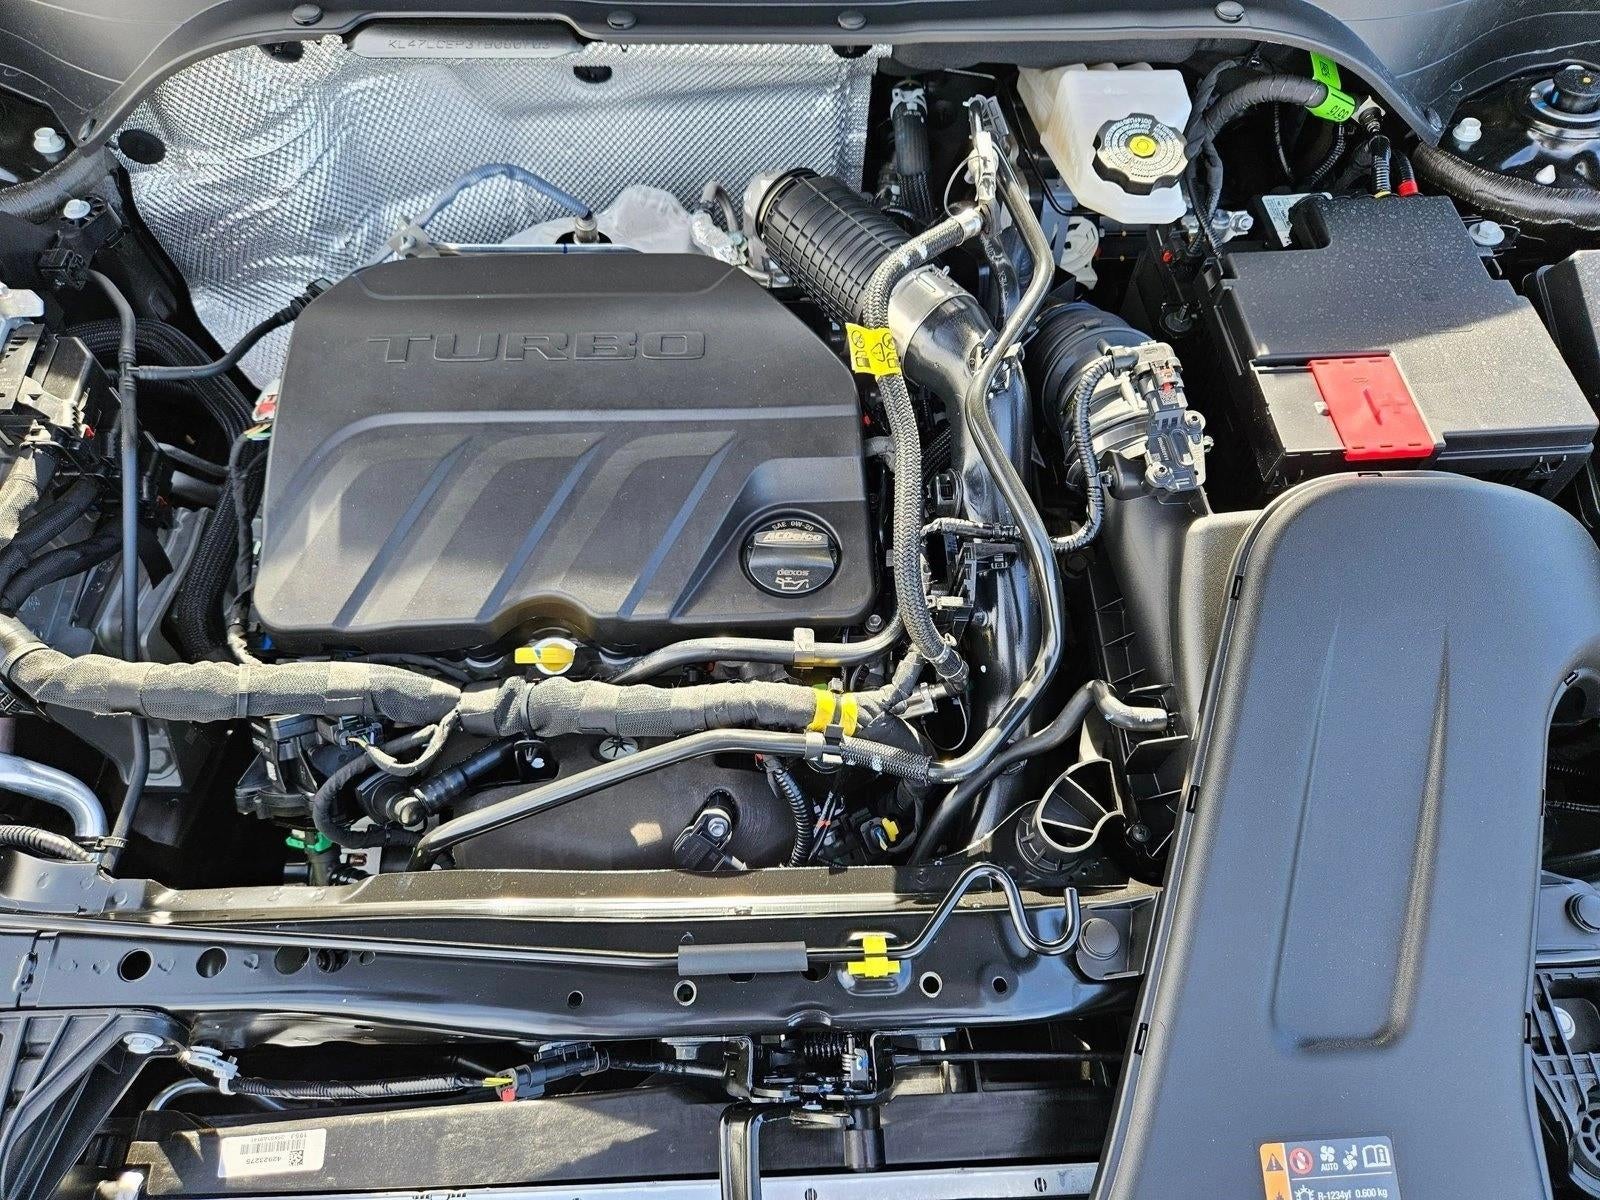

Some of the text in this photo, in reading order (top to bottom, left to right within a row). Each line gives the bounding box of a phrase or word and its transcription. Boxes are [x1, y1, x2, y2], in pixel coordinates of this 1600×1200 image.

[367, 331, 706, 363] TURBO
[1321, 1162, 1339, 1172] AUTO
[1355, 1187, 1377, 1198] 0.600
[1377, 1187, 1388, 1199] kg
